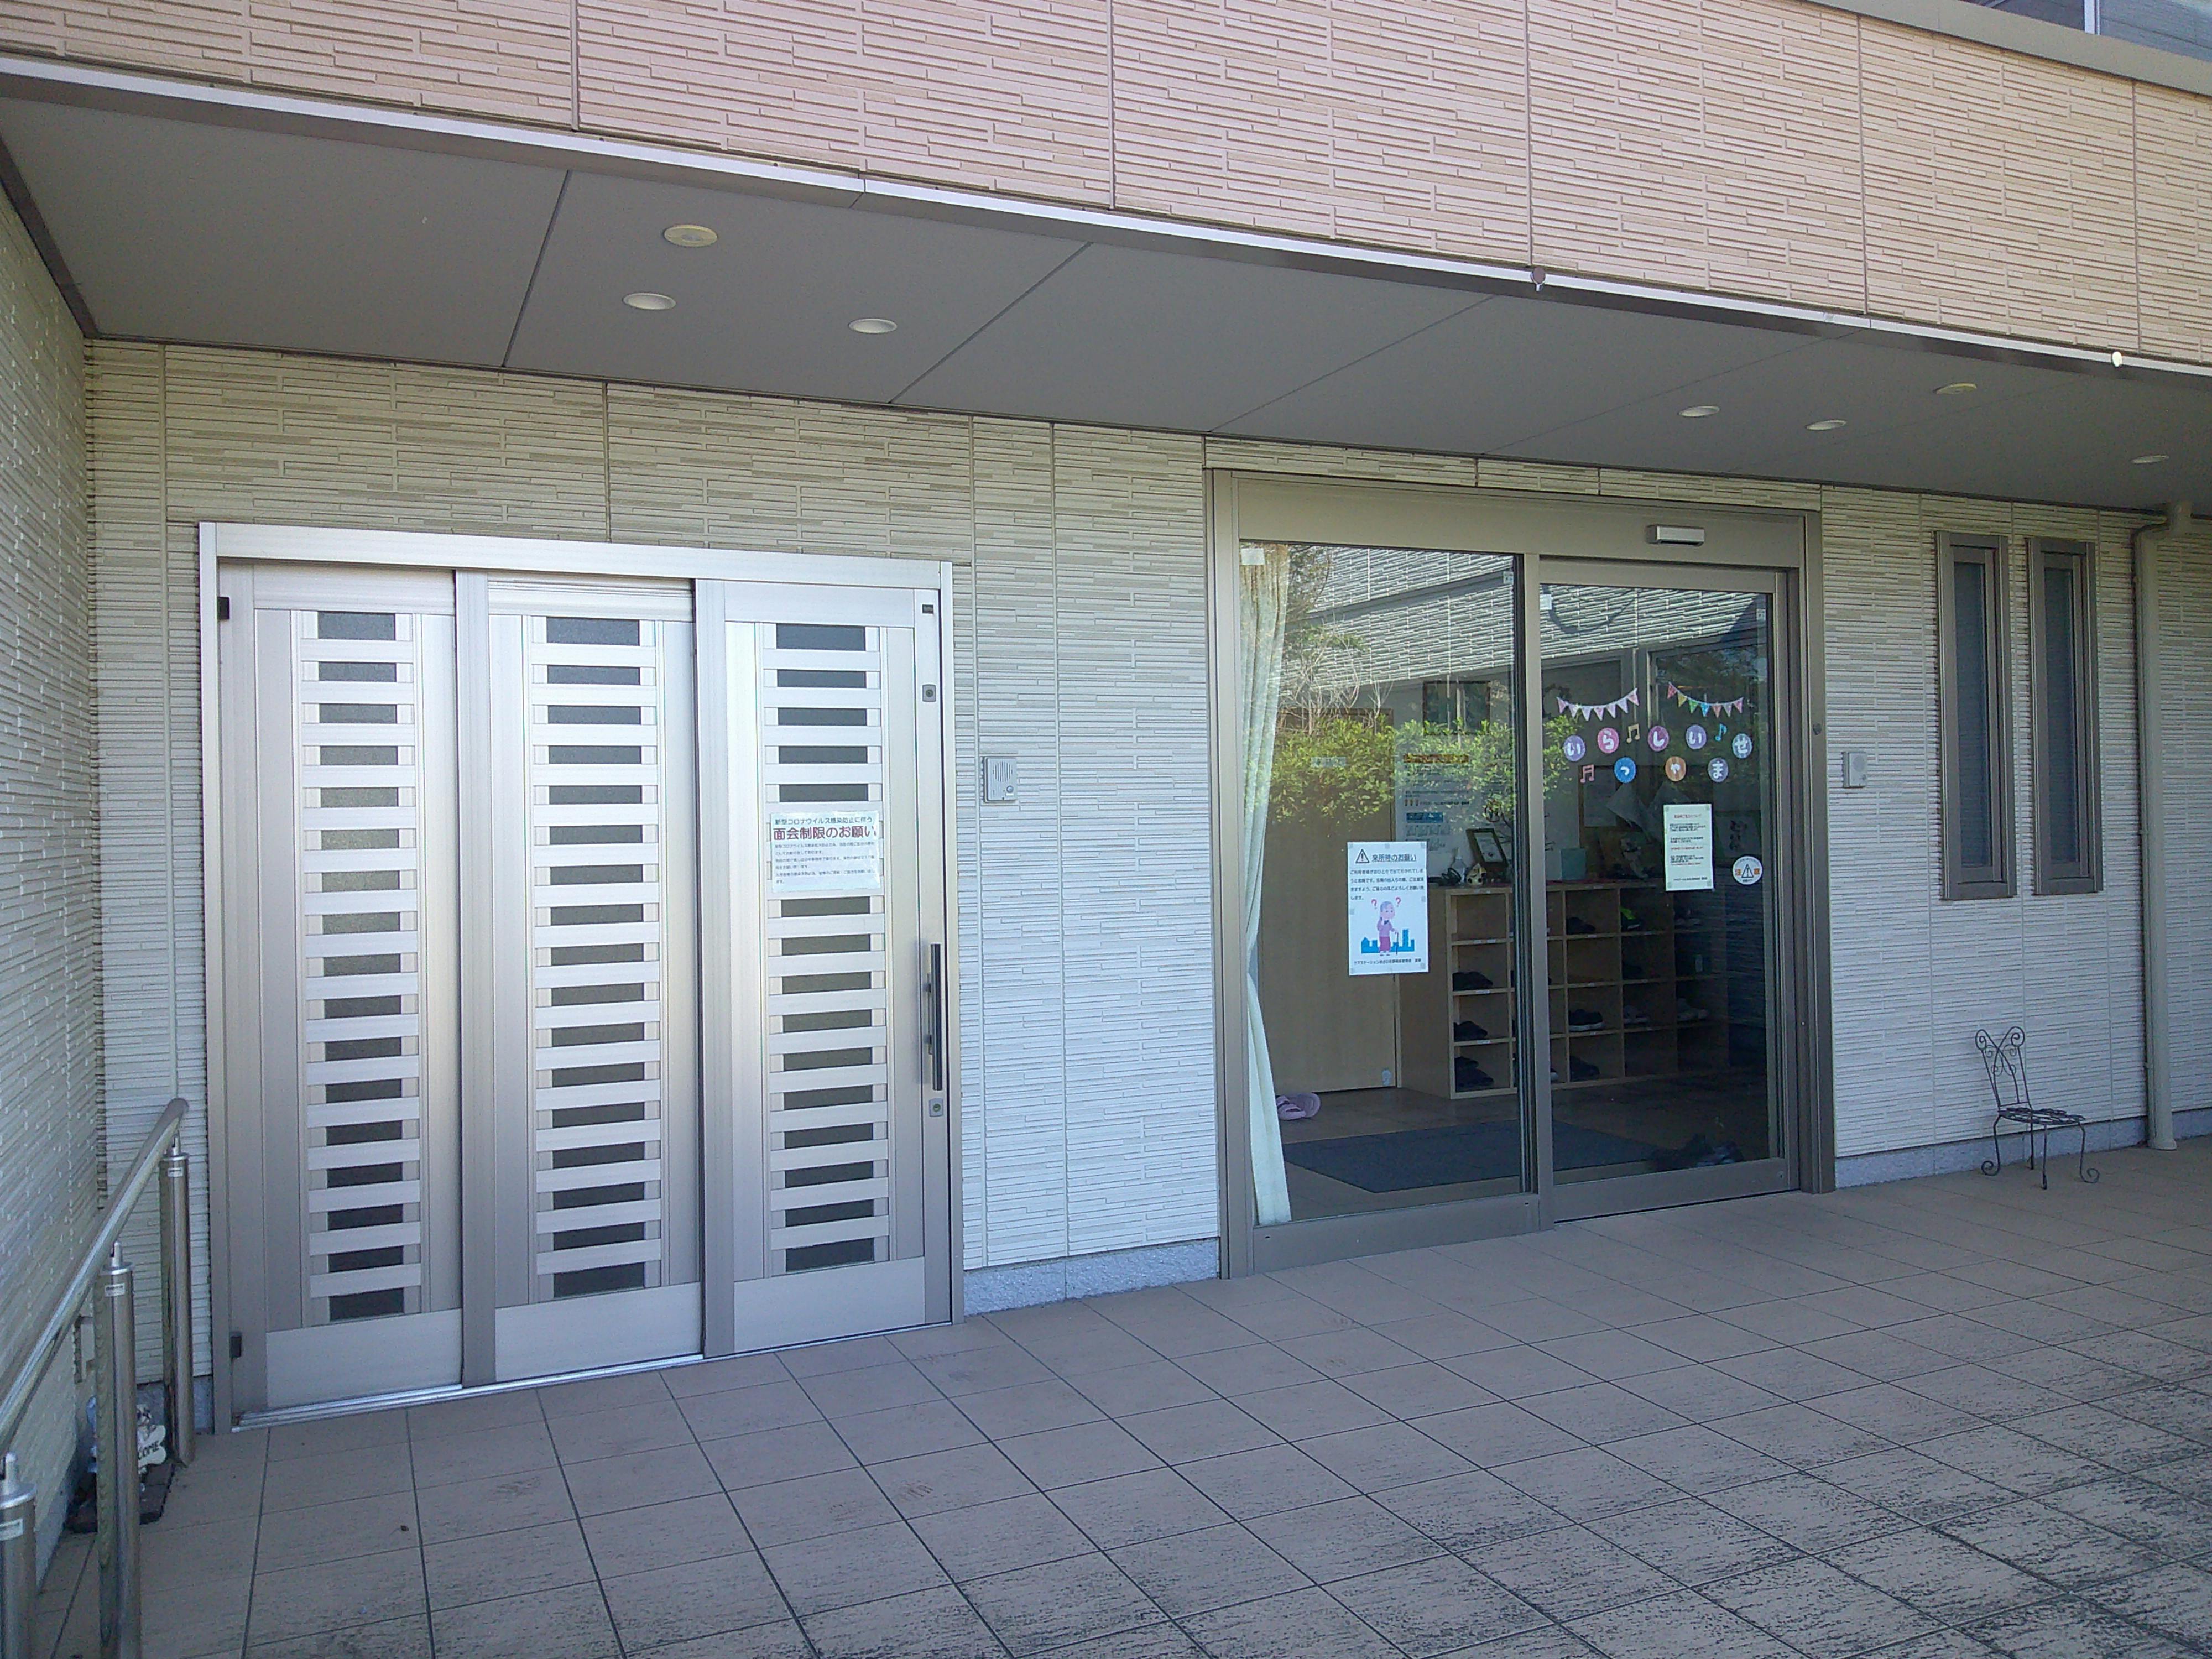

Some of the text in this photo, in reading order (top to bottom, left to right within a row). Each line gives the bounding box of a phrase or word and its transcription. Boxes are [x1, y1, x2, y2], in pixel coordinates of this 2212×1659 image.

[775, 816, 873, 825] 新型コロナウイルス感染防止に伴う
[773, 825, 877, 841] 面会制限のお願い
[1371, 854, 1417, 863] 来所時のお願い
